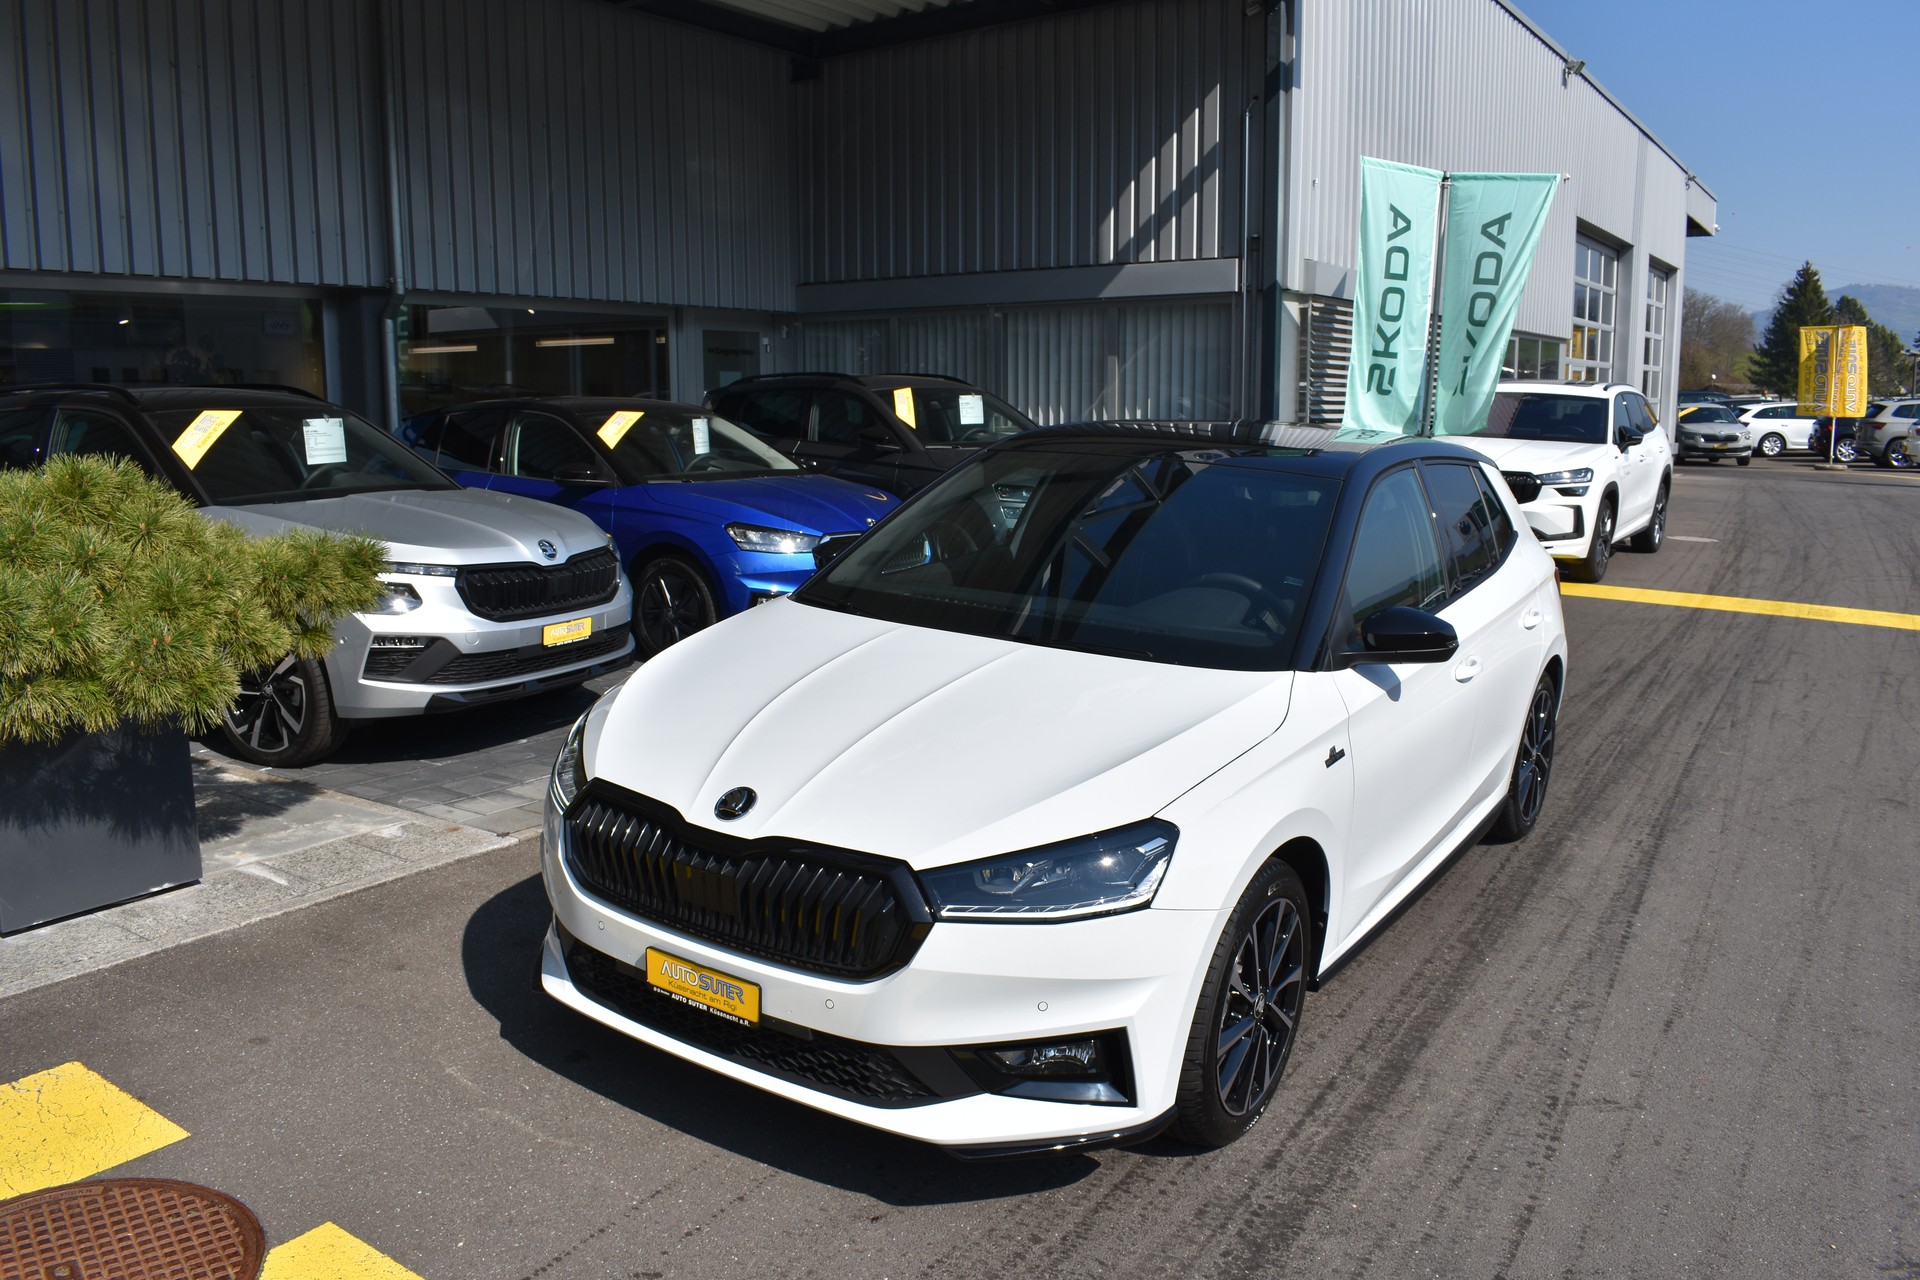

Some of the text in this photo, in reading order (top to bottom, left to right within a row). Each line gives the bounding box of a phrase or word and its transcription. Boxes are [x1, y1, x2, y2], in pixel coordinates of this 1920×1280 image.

[668, 980, 707, 1000] Küssnacht
[709, 996, 721, 1006] am
[723, 1001, 737, 1012] Rigi
[671, 993, 687, 1004] AUTO
[688, 999, 708, 1012] SUTER
